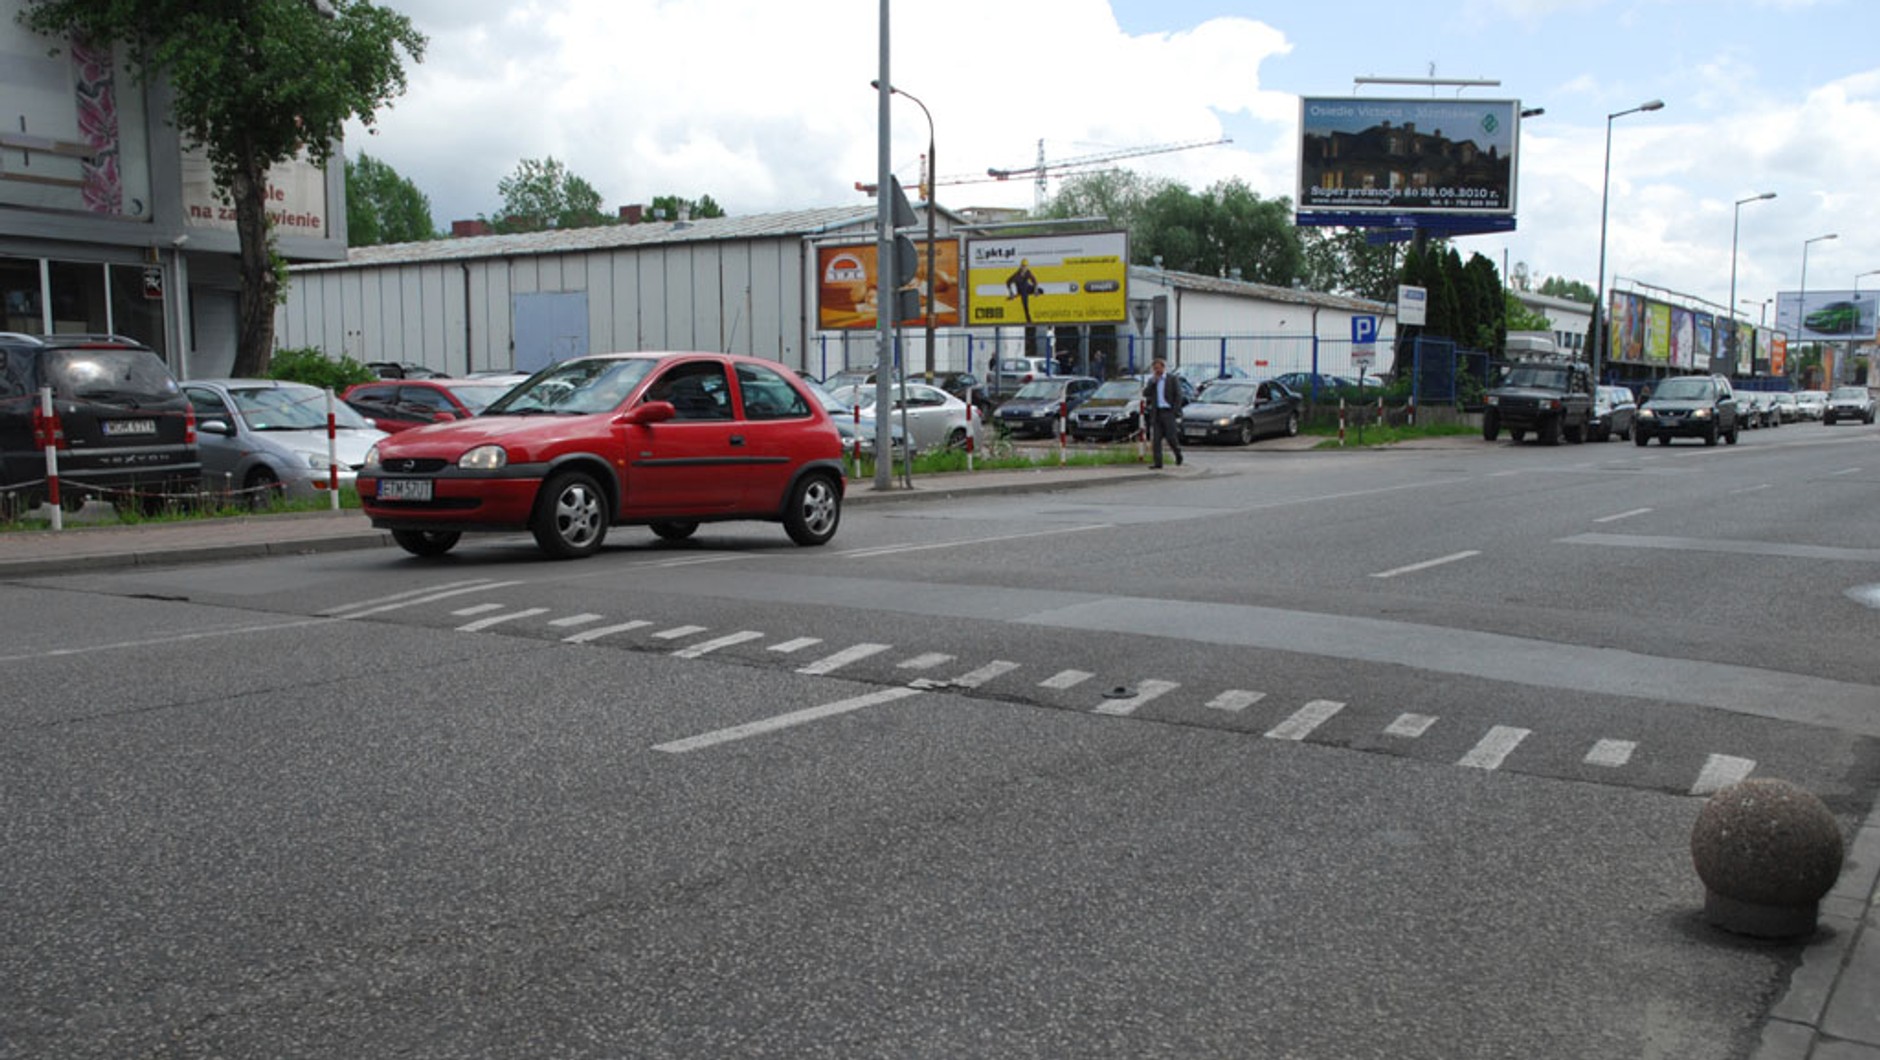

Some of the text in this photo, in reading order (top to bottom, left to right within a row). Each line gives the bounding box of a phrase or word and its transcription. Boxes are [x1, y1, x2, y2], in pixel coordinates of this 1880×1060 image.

[1347, 187, 1402, 199] promocja
[1404, 187, 1419, 198] do
[190, 205, 213, 220] na
[1356, 319, 1372, 341] P
